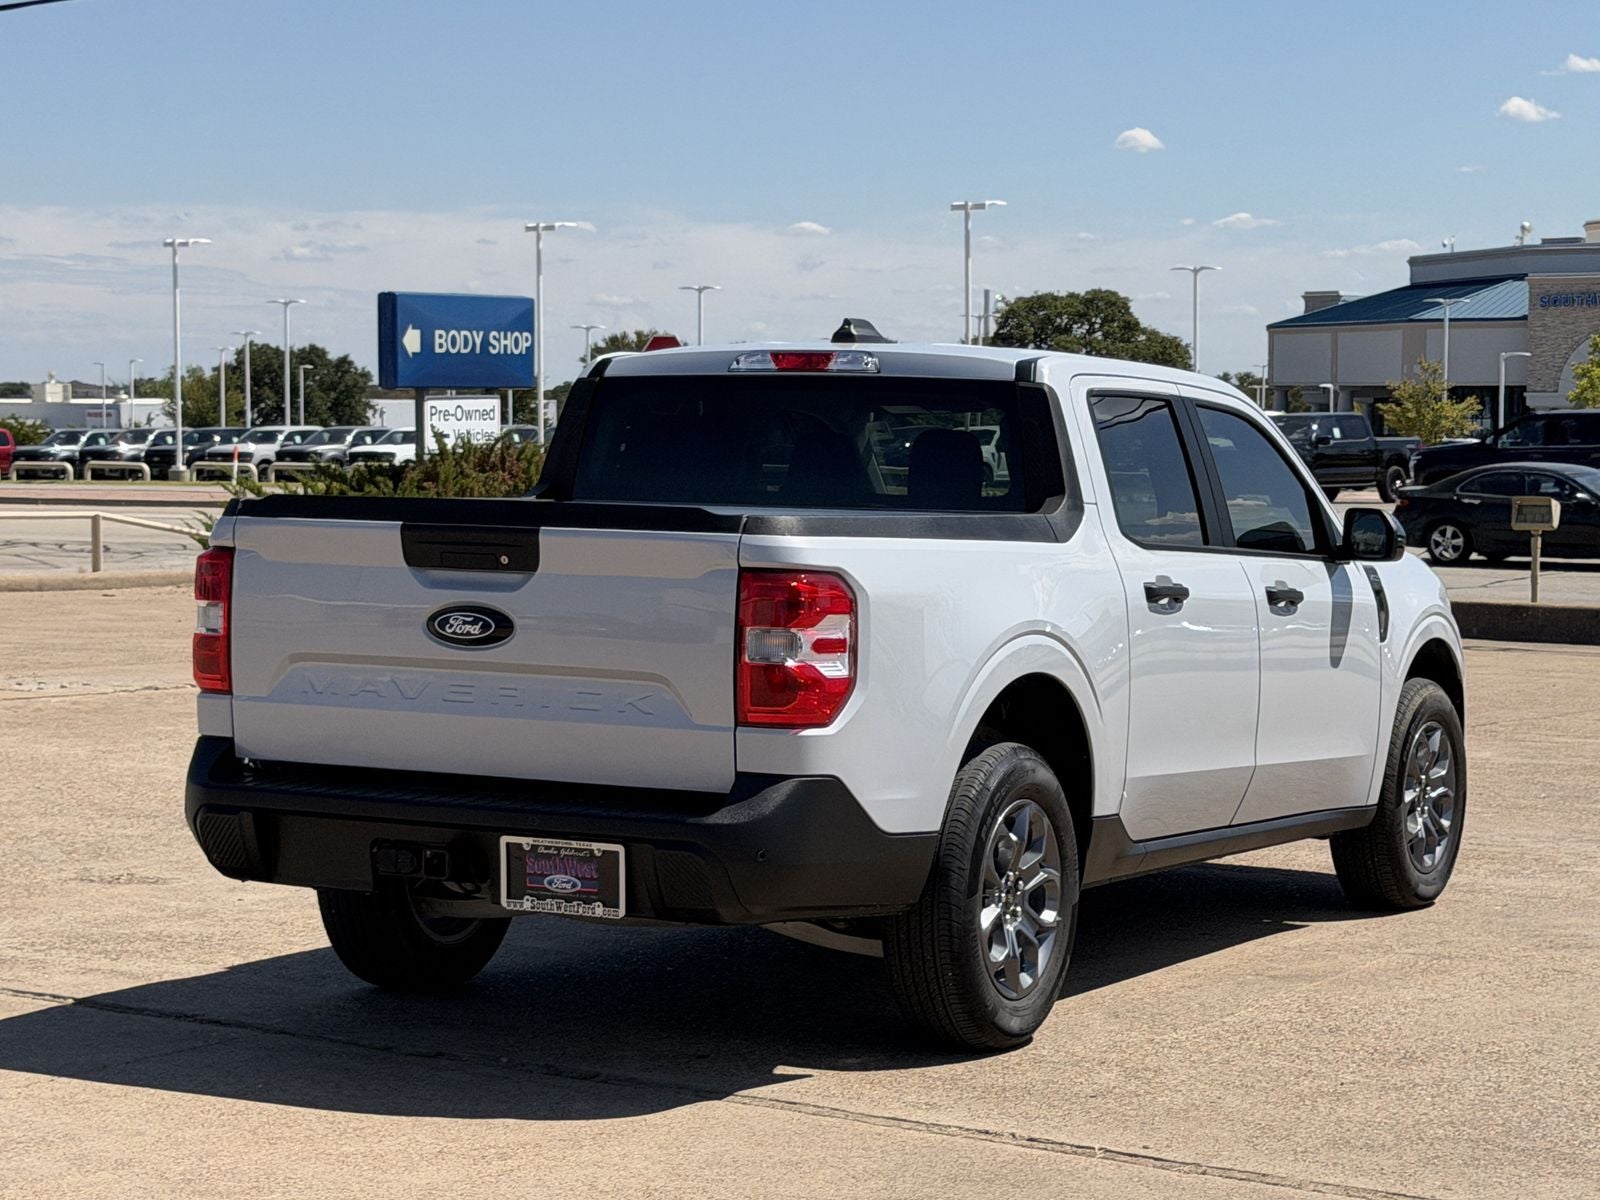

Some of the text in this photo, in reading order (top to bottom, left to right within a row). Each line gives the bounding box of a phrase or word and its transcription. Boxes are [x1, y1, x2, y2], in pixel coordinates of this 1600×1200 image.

[1539, 293, 1600, 308] SOUTH
[434, 329, 532, 355] BODY SHOP
[429, 405, 495, 422] Pre-Owned
[445, 615, 483, 634] Ford
[300, 672, 654, 716] MAVERICK
[551, 878, 573, 889] Ford
